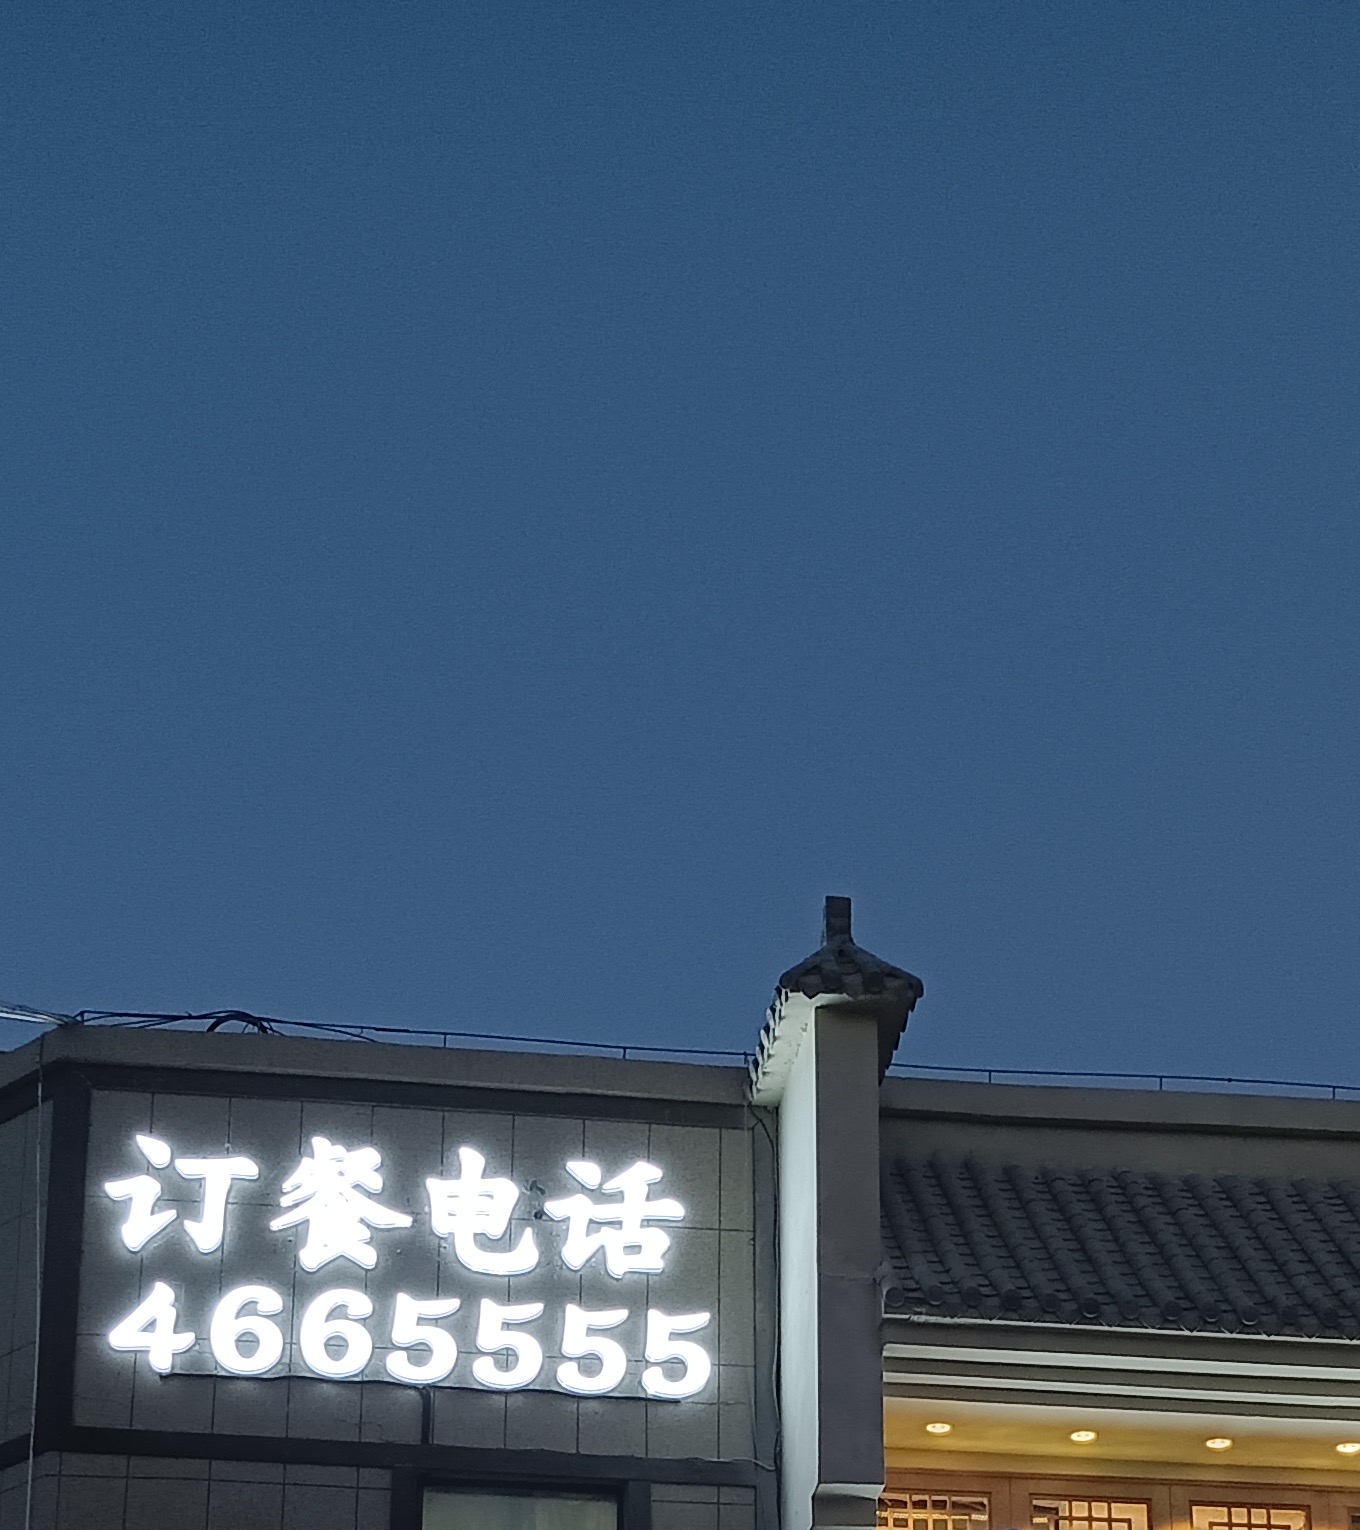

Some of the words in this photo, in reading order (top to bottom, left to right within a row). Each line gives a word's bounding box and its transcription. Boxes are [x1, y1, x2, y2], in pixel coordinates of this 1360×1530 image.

[104, 1134, 686, 1278] 订餐电话
[108, 1281, 711, 1399] 4665555
